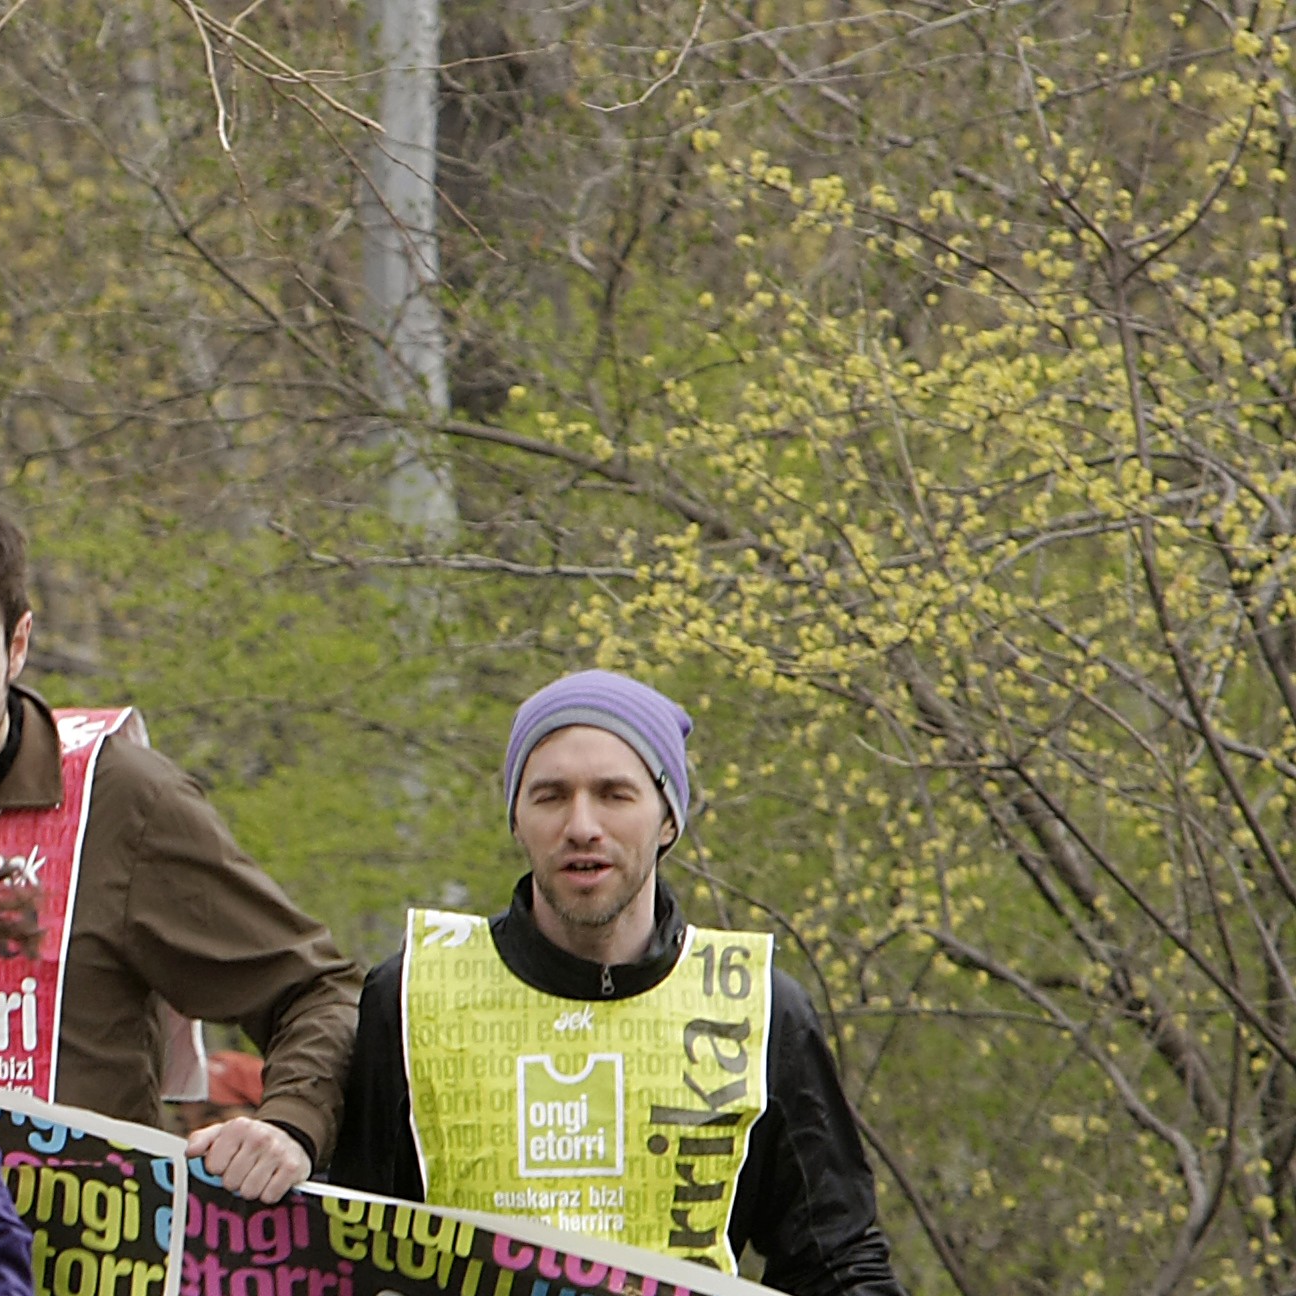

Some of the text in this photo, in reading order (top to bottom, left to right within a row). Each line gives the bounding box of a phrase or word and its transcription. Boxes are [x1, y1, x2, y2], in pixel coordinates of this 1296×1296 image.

[693, 944, 752, 1001] 16
[554, 1004, 594, 1032] aek
[529, 1095, 588, 1131] ongi
[529, 1132, 606, 1162] etorri
[2, 1165, 141, 1254] ongi
[494, 1185, 624, 1208] euskaraz bizi
[558, 1210, 625, 1232] herrira
